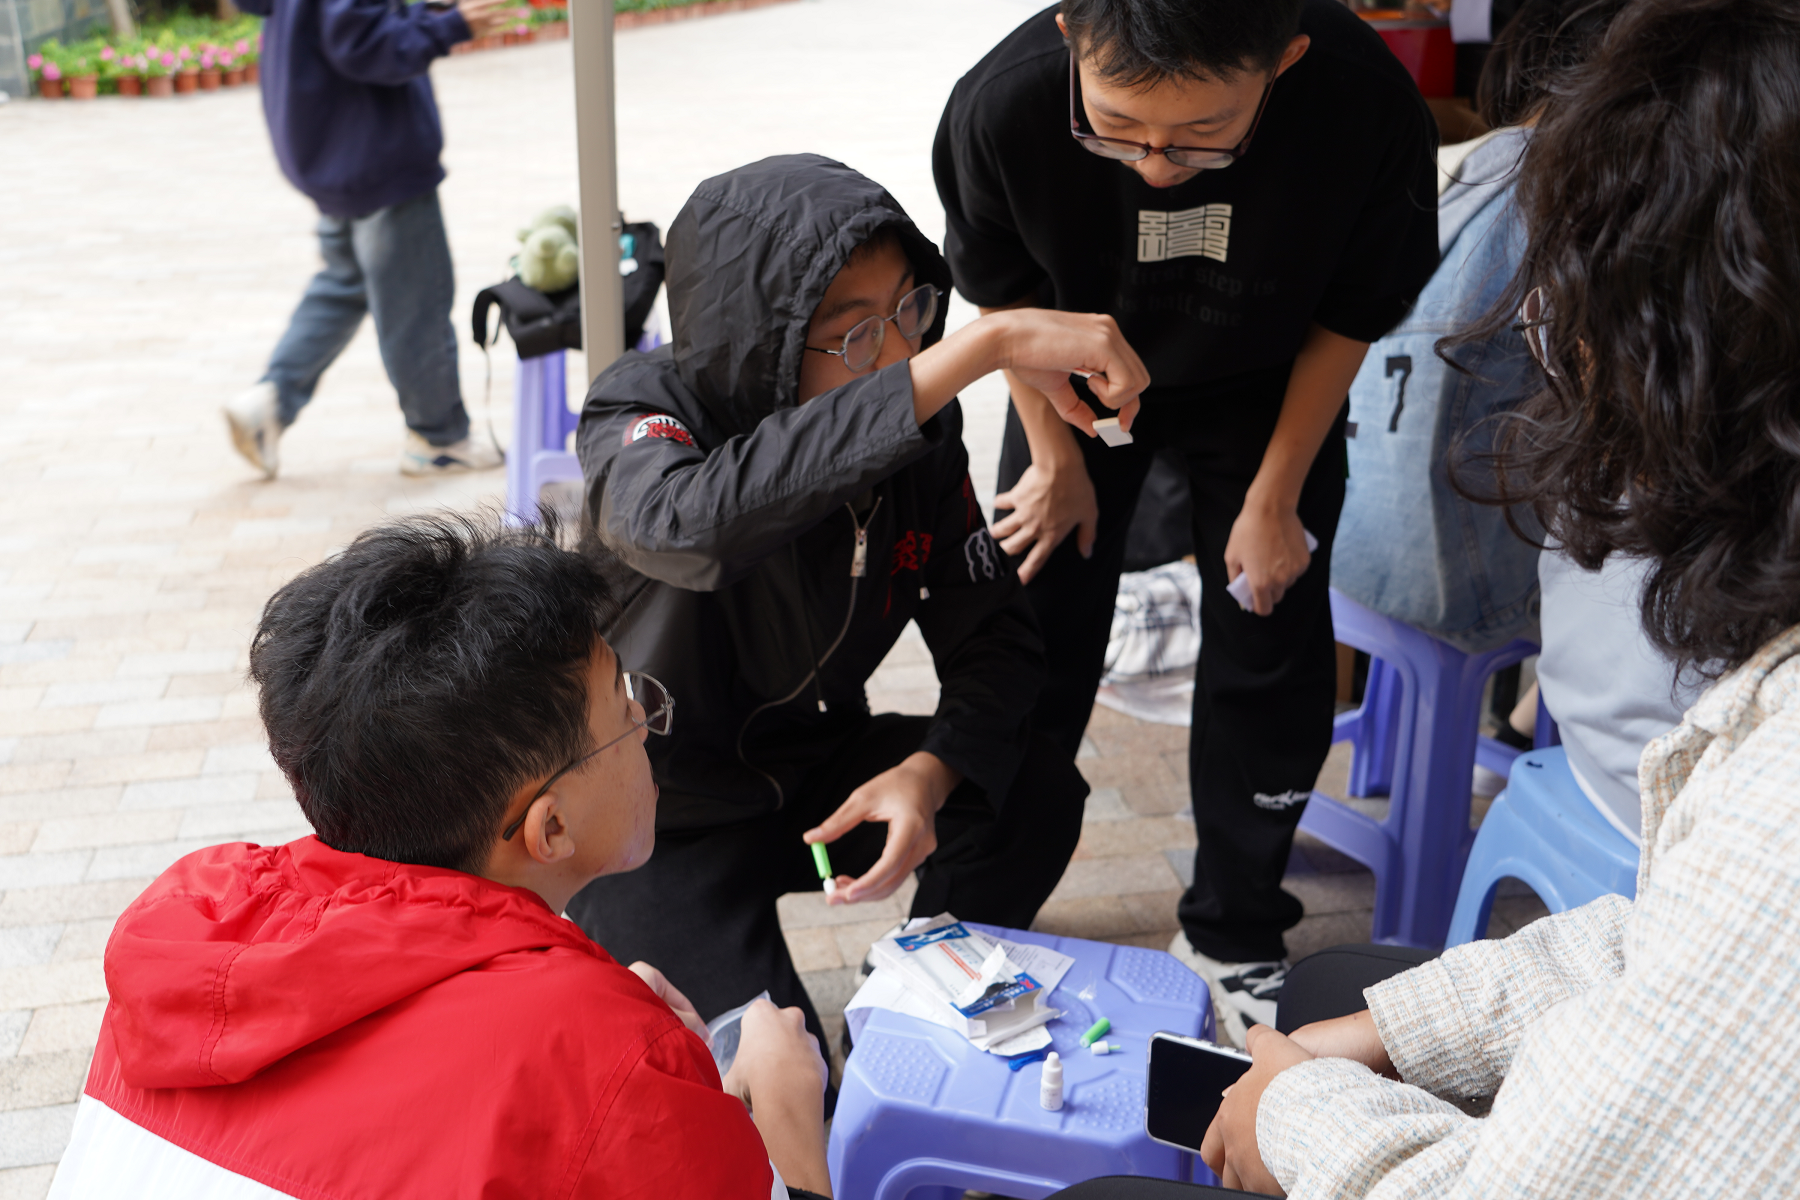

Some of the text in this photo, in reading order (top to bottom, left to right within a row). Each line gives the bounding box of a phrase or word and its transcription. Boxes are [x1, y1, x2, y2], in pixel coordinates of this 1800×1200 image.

[1130, 263, 1187, 286] first
[1194, 266, 1243, 299] step
[1252, 275, 1278, 297] is
